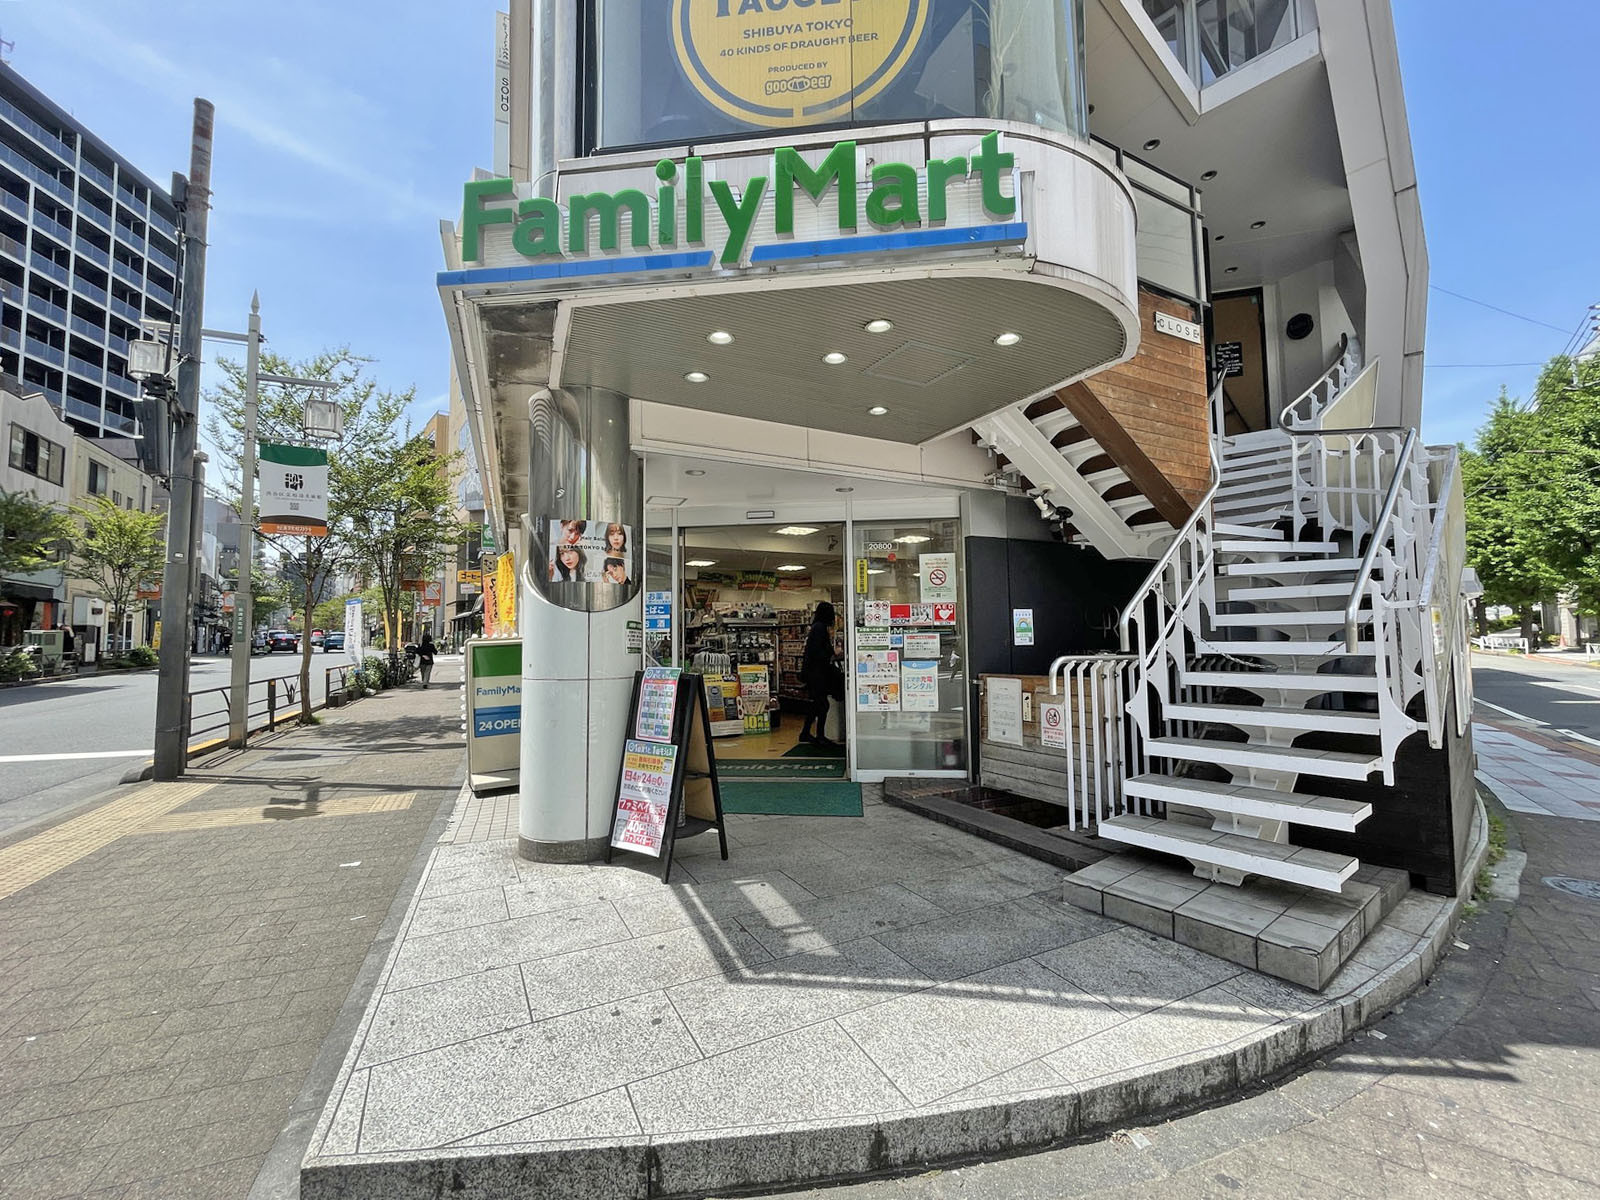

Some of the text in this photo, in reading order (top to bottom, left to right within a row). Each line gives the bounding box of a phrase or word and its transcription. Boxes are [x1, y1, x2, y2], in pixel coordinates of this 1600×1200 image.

[743, 18, 854, 39] SHIBUYA TOKYO
[720, 32, 879, 57] 40 KINDS OF DRAUGHT BEER
[768, 61, 828, 73] PRODUCED BY
[462, 130, 1016, 264] FamilyMart
[1158, 319, 1200, 338] CLOSE
[479, 721, 493, 731] 24
